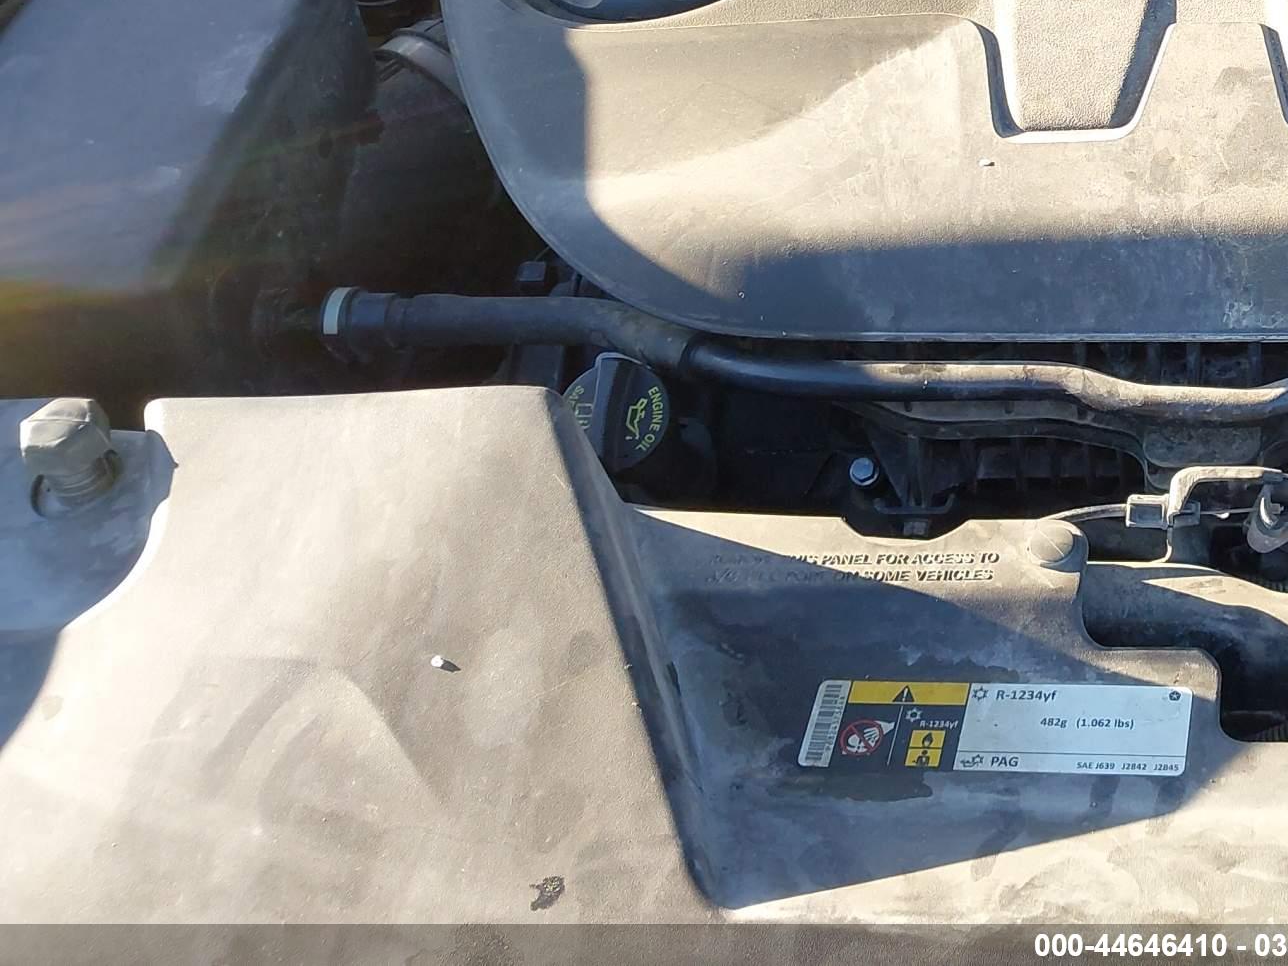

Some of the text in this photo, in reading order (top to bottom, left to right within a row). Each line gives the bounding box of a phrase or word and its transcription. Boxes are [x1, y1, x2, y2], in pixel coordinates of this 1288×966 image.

[635, 386, 664, 451] ENGINE OIL
[820, 553, 873, 565] PANEL
[875, 553, 910, 565] FOR
[911, 552, 976, 565] ACCESS
[979, 552, 1000, 564] TO
[864, 570, 911, 582] SOME
[915, 569, 994, 582] VEHICLES
[995, 689, 1057, 702] R-1234yf
[920, 719, 959, 730] R-1234yf
[1040, 717, 1134, 730] 482g (1.062 lbs)
[990, 756, 1019, 767] PAG
[1076, 761, 1093, 770] SAE
[1095, 761, 1115, 770] J639
